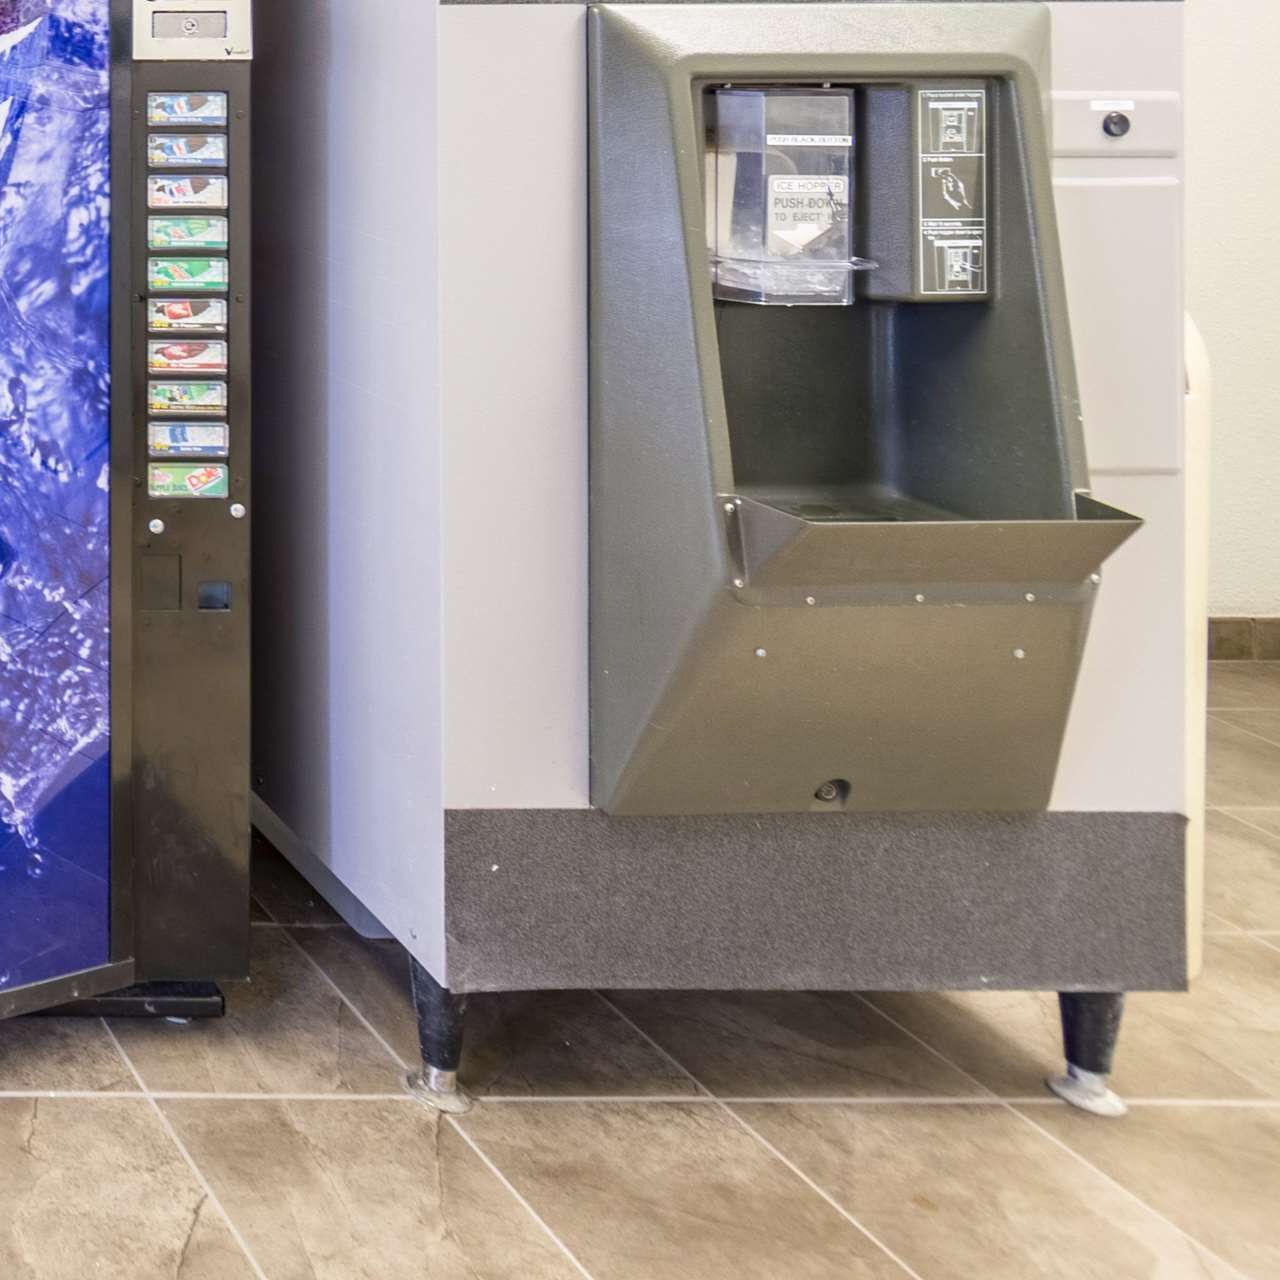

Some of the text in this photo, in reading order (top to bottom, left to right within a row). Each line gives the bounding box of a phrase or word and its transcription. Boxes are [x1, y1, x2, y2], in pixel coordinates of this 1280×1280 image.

[776, 182, 793, 190] ICE
[774, 197, 804, 209] PUSH
[187, 466, 219, 488] Dole
